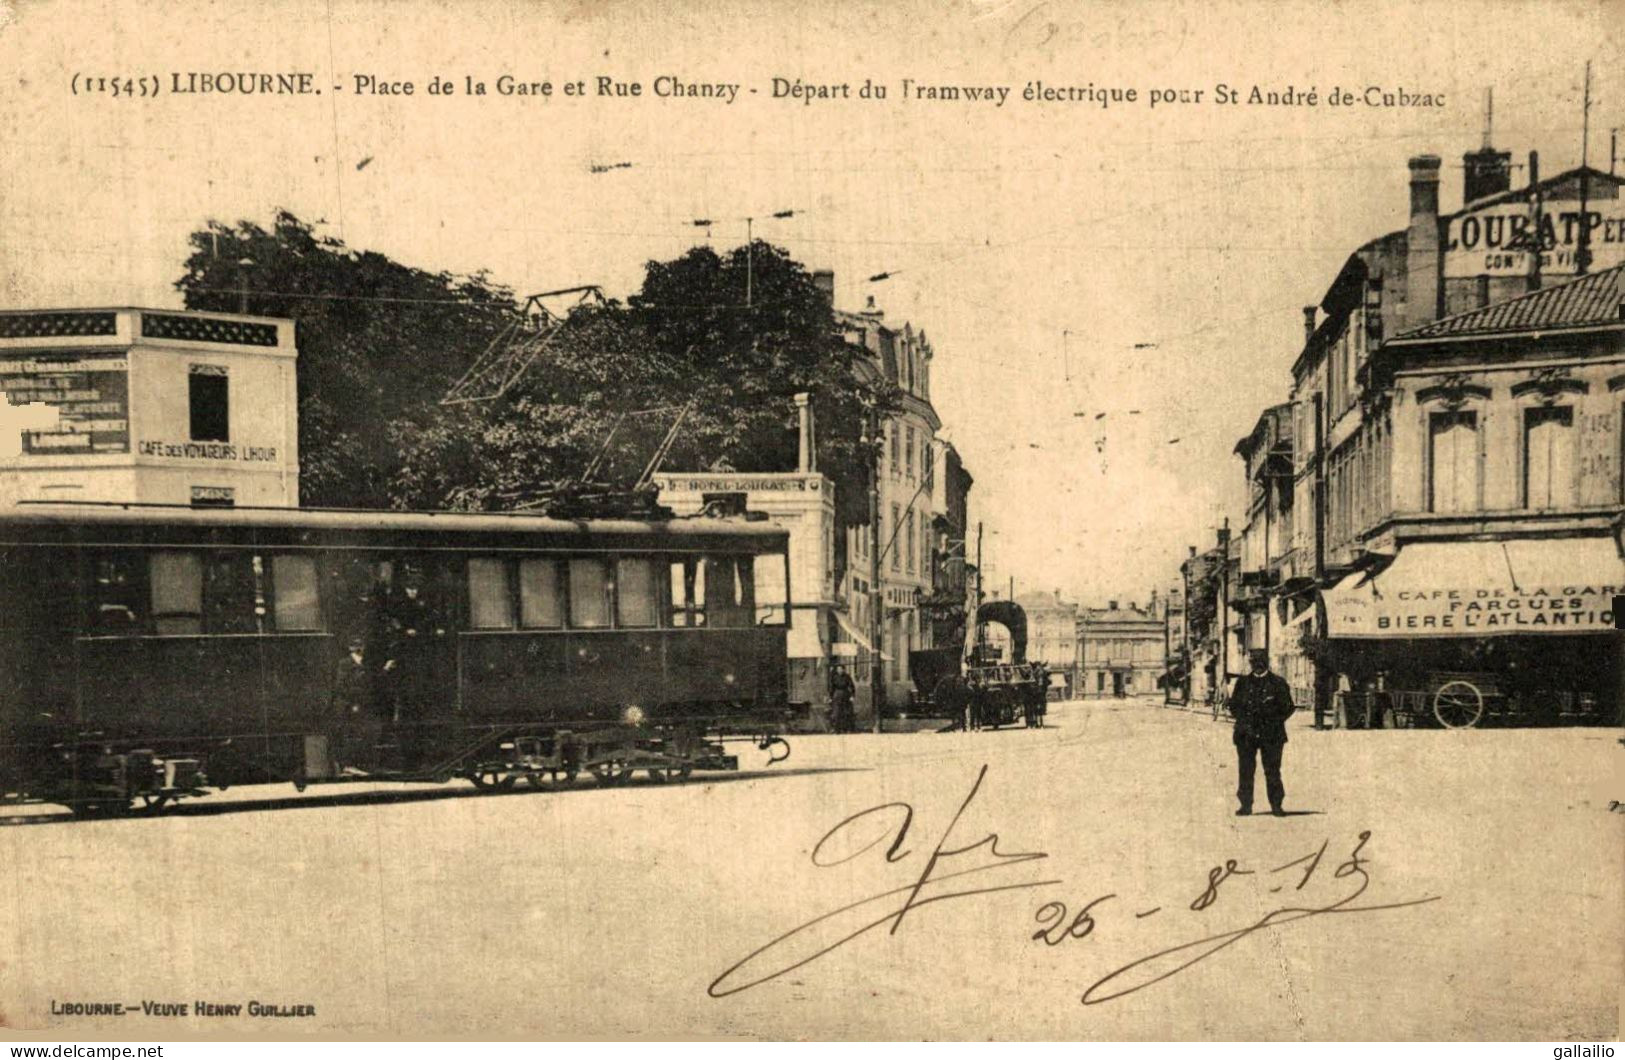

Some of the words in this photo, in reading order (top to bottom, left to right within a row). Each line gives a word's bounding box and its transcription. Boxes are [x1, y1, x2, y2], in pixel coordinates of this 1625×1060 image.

[1438, 212, 1579, 251] LOUBAT
[165, 444, 183, 458] DES
[183, 443, 237, 460] VOYAGEURS
[1397, 590, 1461, 600] CAFE
[1476, 588, 1505, 599] DE
[1519, 587, 1549, 598] LA
[1378, 614, 1454, 629] BIERE
[1032, 894, 1117, 946] 26
